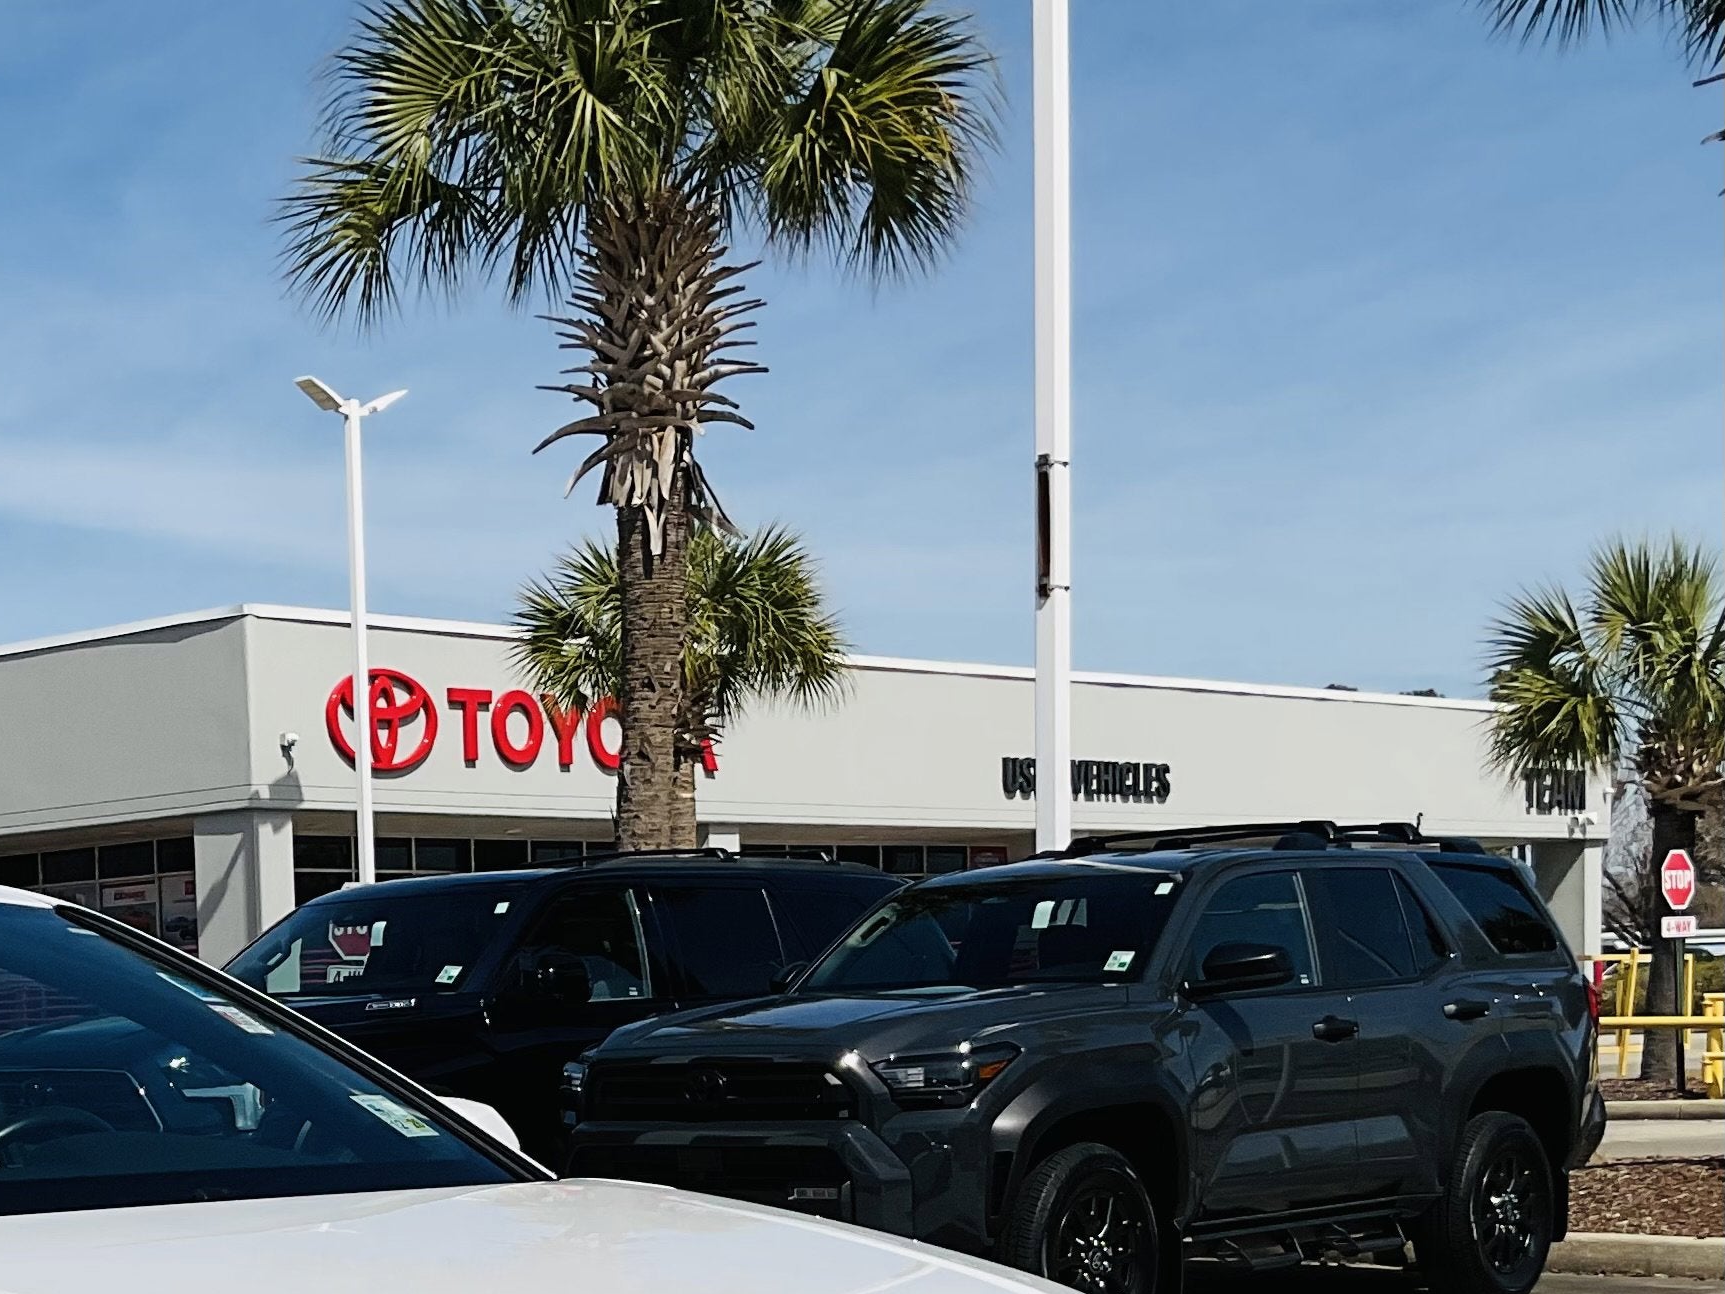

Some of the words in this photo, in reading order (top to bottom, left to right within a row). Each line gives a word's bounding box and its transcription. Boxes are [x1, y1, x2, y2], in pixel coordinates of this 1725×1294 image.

[447, 687, 718, 772] TOYO
[1001, 757, 1037, 795] US
[1070, 759, 1171, 800] VEHICLES
[1522, 767, 1586, 812] TEAM
[1664, 869, 1692, 890] STOP
[1666, 920, 1692, 933] 4-WAY
